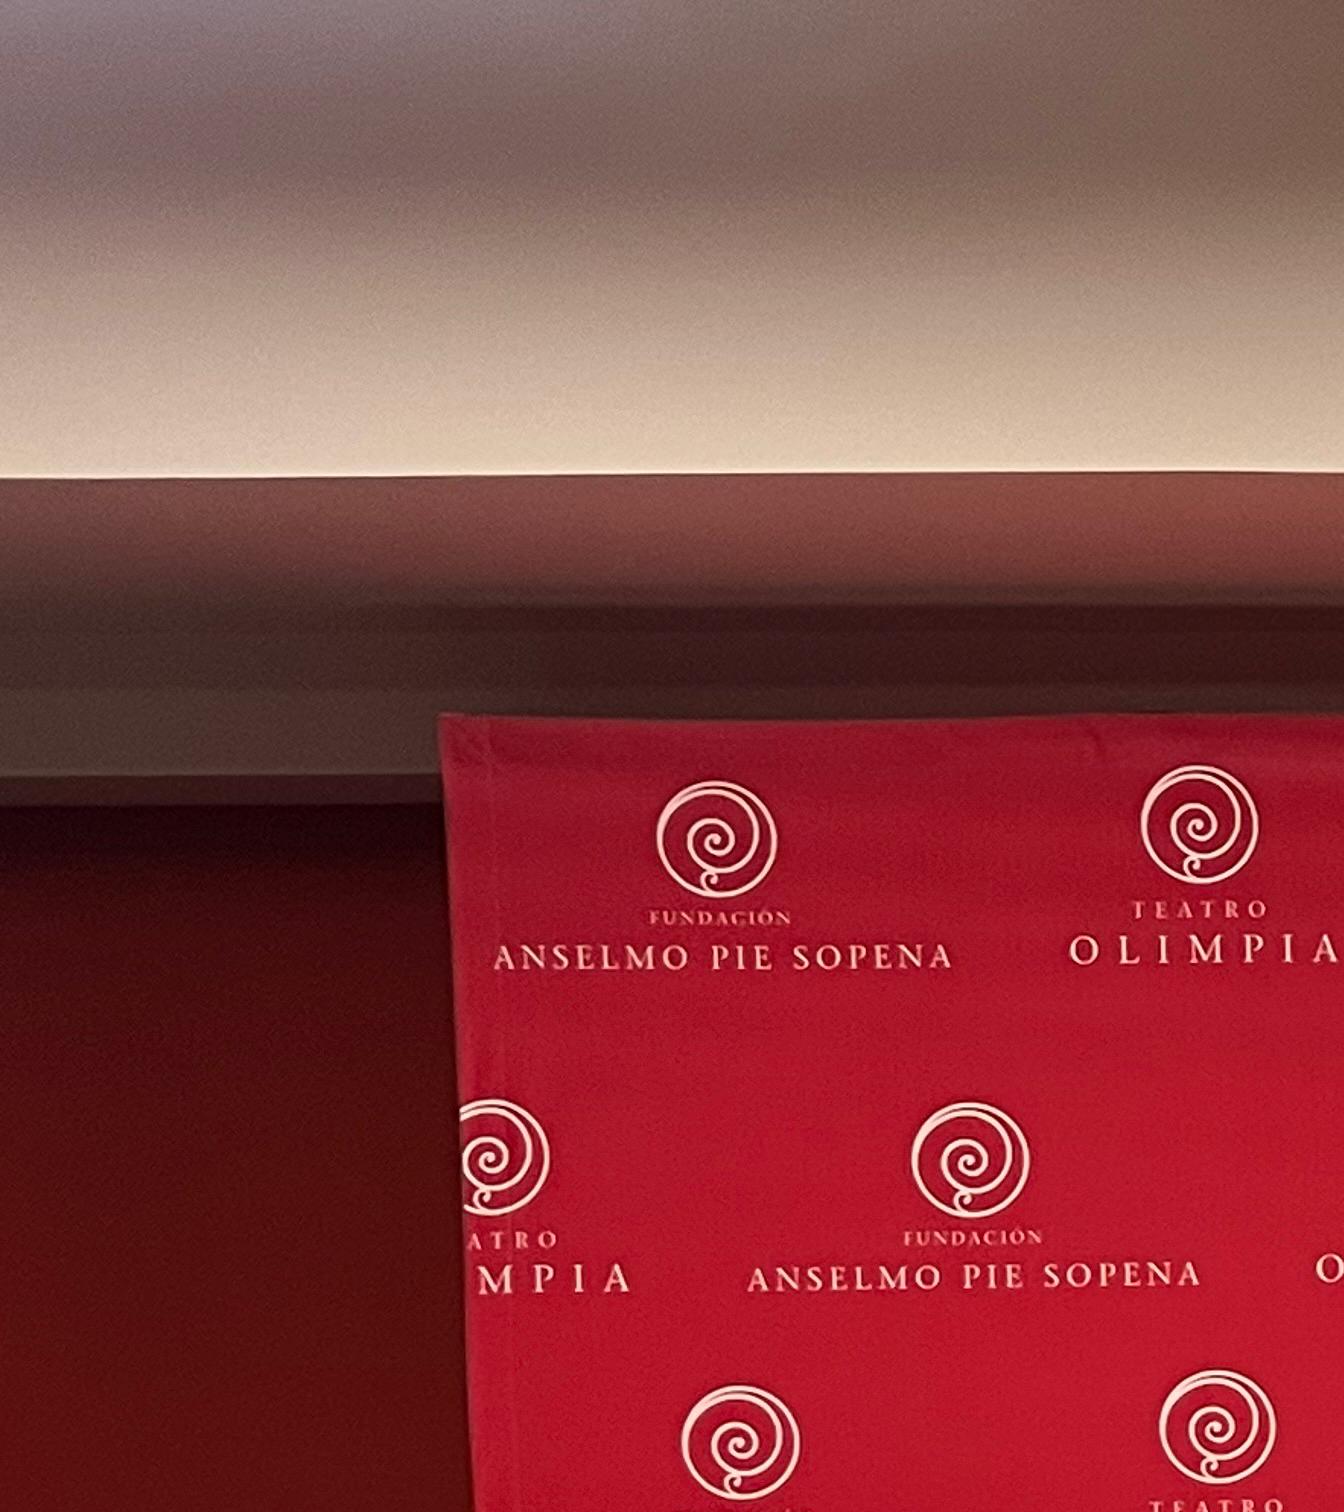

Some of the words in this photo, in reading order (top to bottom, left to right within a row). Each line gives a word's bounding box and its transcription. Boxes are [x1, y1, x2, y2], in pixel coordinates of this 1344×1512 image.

[650, 907, 791, 926] FUNDACIÓN
[1134, 899, 1267, 919] TEATRO
[493, 944, 688, 971] ANSELMO
[711, 944, 772, 971] PIE
[793, 943, 951, 970] SOPENA
[1068, 933, 1339, 966] OLIMPIA
[467, 1231, 557, 1250] ATRO
[903, 1227, 1042, 1247] FUNDACIÓN
[477, 1263, 630, 1296] MPIA
[747, 1264, 940, 1293] ANSELMO
[963, 1263, 1023, 1290] PIE
[1043, 1261, 1200, 1288] SOPENA
